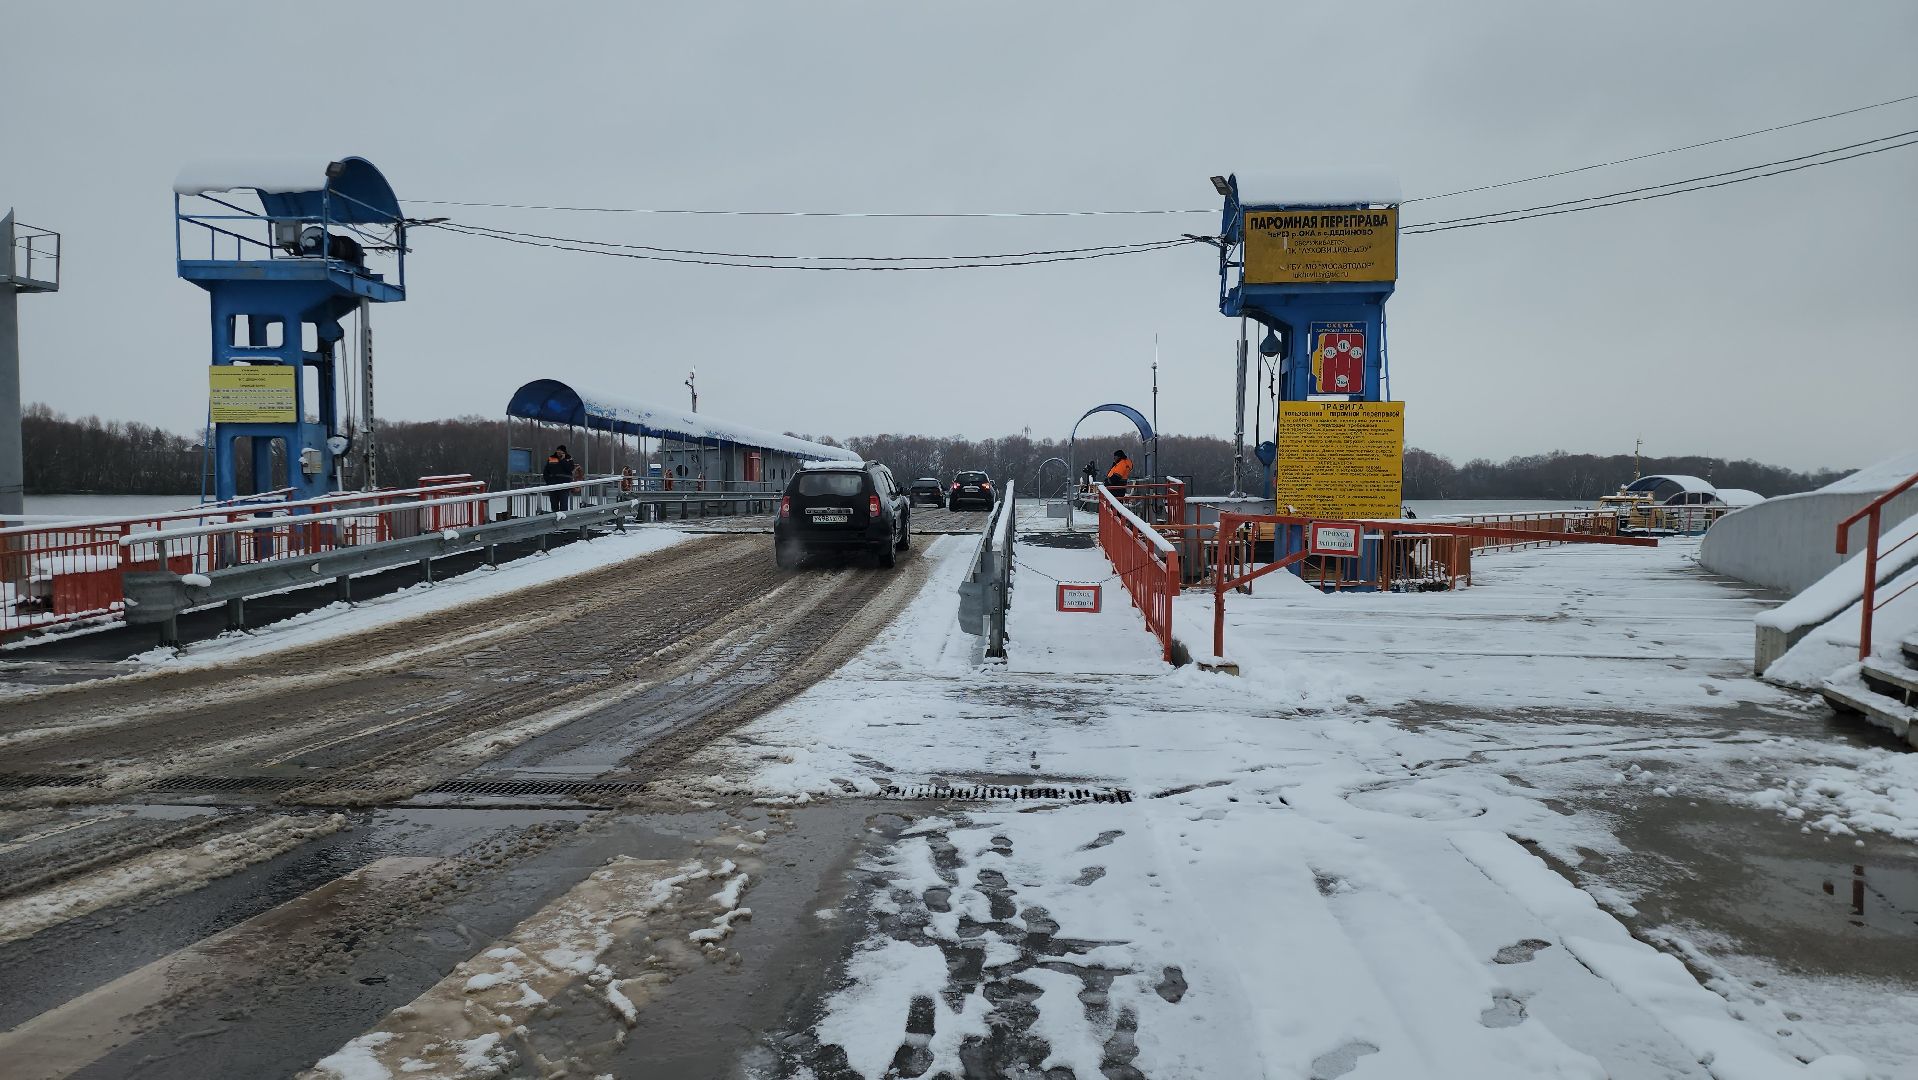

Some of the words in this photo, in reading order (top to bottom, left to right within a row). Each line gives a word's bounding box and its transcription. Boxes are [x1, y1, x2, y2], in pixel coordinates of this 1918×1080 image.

[1250, 216, 1317, 230] ПАРОМНАЯ
[1320, 214, 1388, 228] ПЕРЕПРАВА
[1320, 403, 1365, 411] ПРАВИЛА
[1362, 409, 1400, 418] переправой
[1322, 530, 1350, 538] ПРОХОД
[1318, 540, 1353, 548] ЗАПРЕЩЕН
